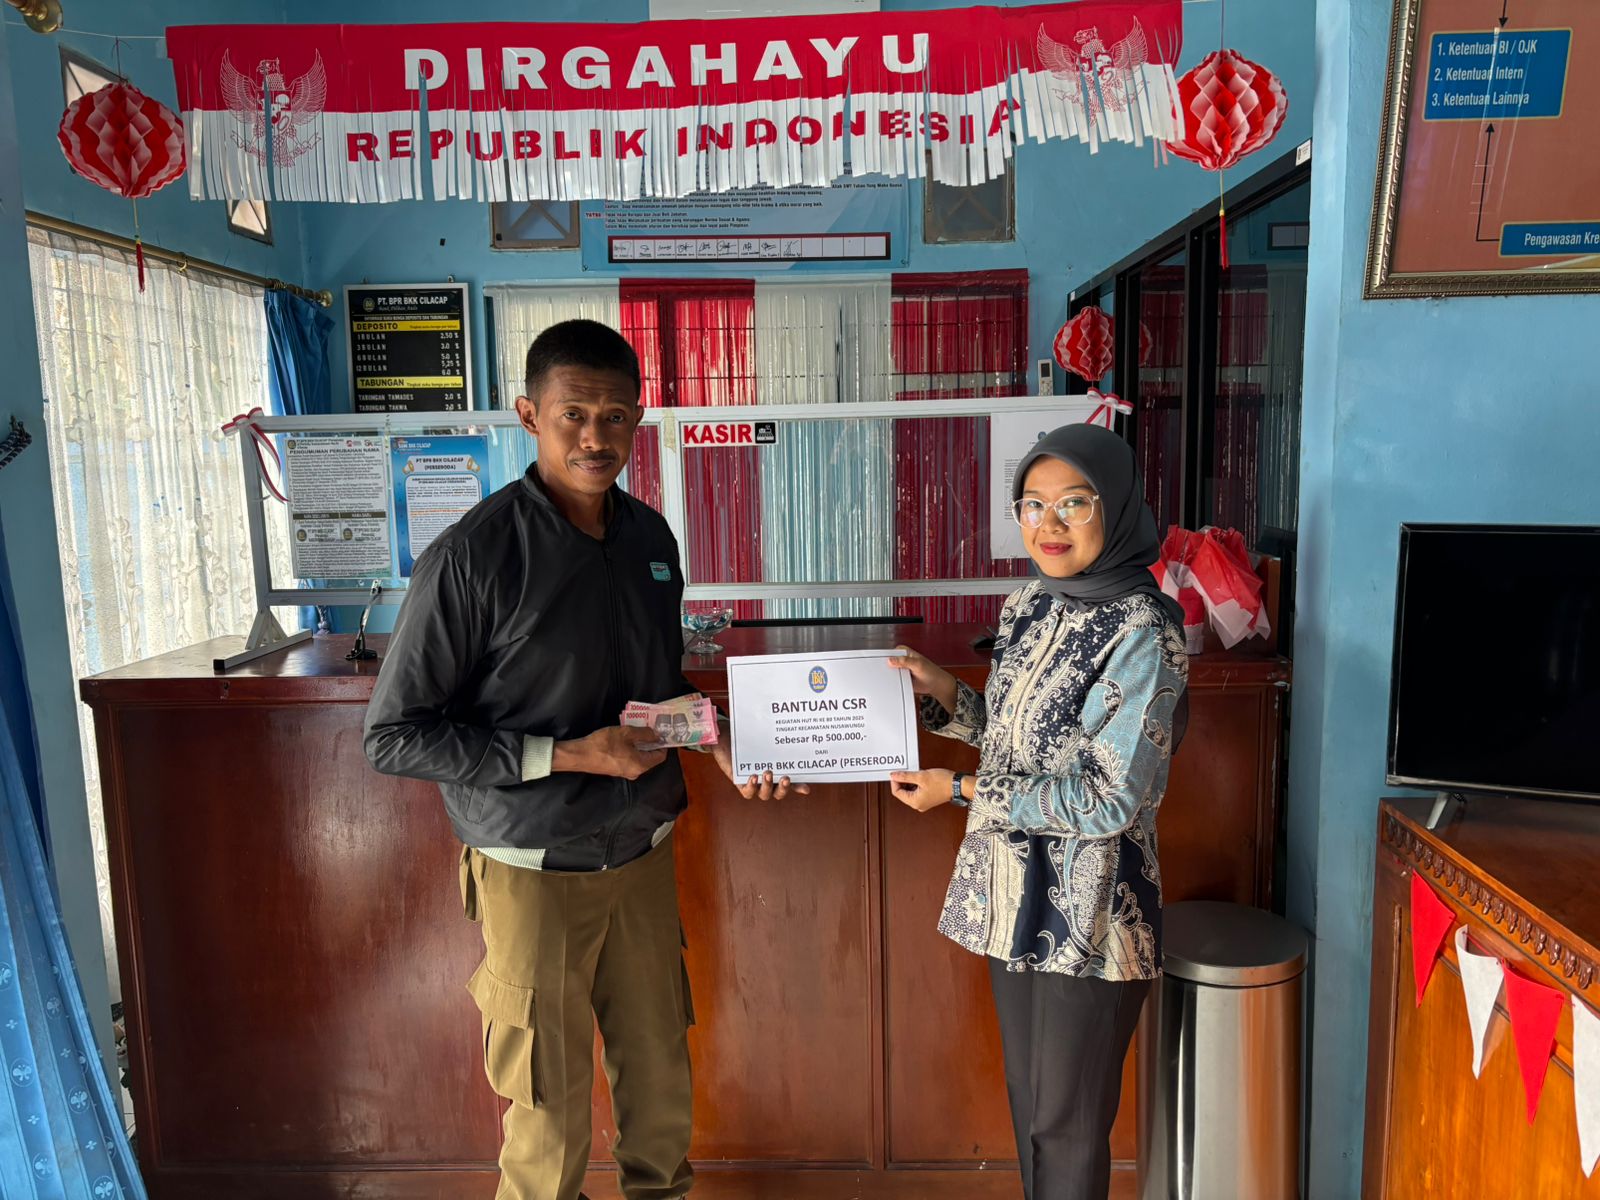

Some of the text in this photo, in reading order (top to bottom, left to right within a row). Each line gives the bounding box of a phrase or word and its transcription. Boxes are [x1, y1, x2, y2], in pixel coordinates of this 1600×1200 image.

[1438, 43, 1446, 56] 1.
[1449, 41, 1497, 56] Ketentuan
[1499, 40, 1509, 53] BI
[1518, 39, 1538, 53] OJK
[404, 33, 929, 91] DIRGAHAYU
[1434, 67, 1524, 81] 2. Ketentuan Intern
[1431, 91, 1530, 107] 3. Ketentuan Lainnya
[347, 97, 1021, 162] REPUBLIK INDONESIA
[1524, 232, 1582, 248] Pengawasan
[377, 297, 388, 305] PT.
[389, 297, 402, 305] BPR
[403, 296, 418, 305] BKK
[419, 296, 448, 305] CILACAP
[360, 379, 404, 387] TABUNGAN
[683, 424, 753, 444] KASIR
[771, 698, 867, 714] BANTUAN CSR
[774, 732, 867, 745] Sebesar Rp 500.000,-
[754, 763, 773, 771] BPR
[776, 761, 795, 770] BKK
[797, 759, 838, 769] CILACAP
[840, 755, 905, 769] (PERSERODA)
